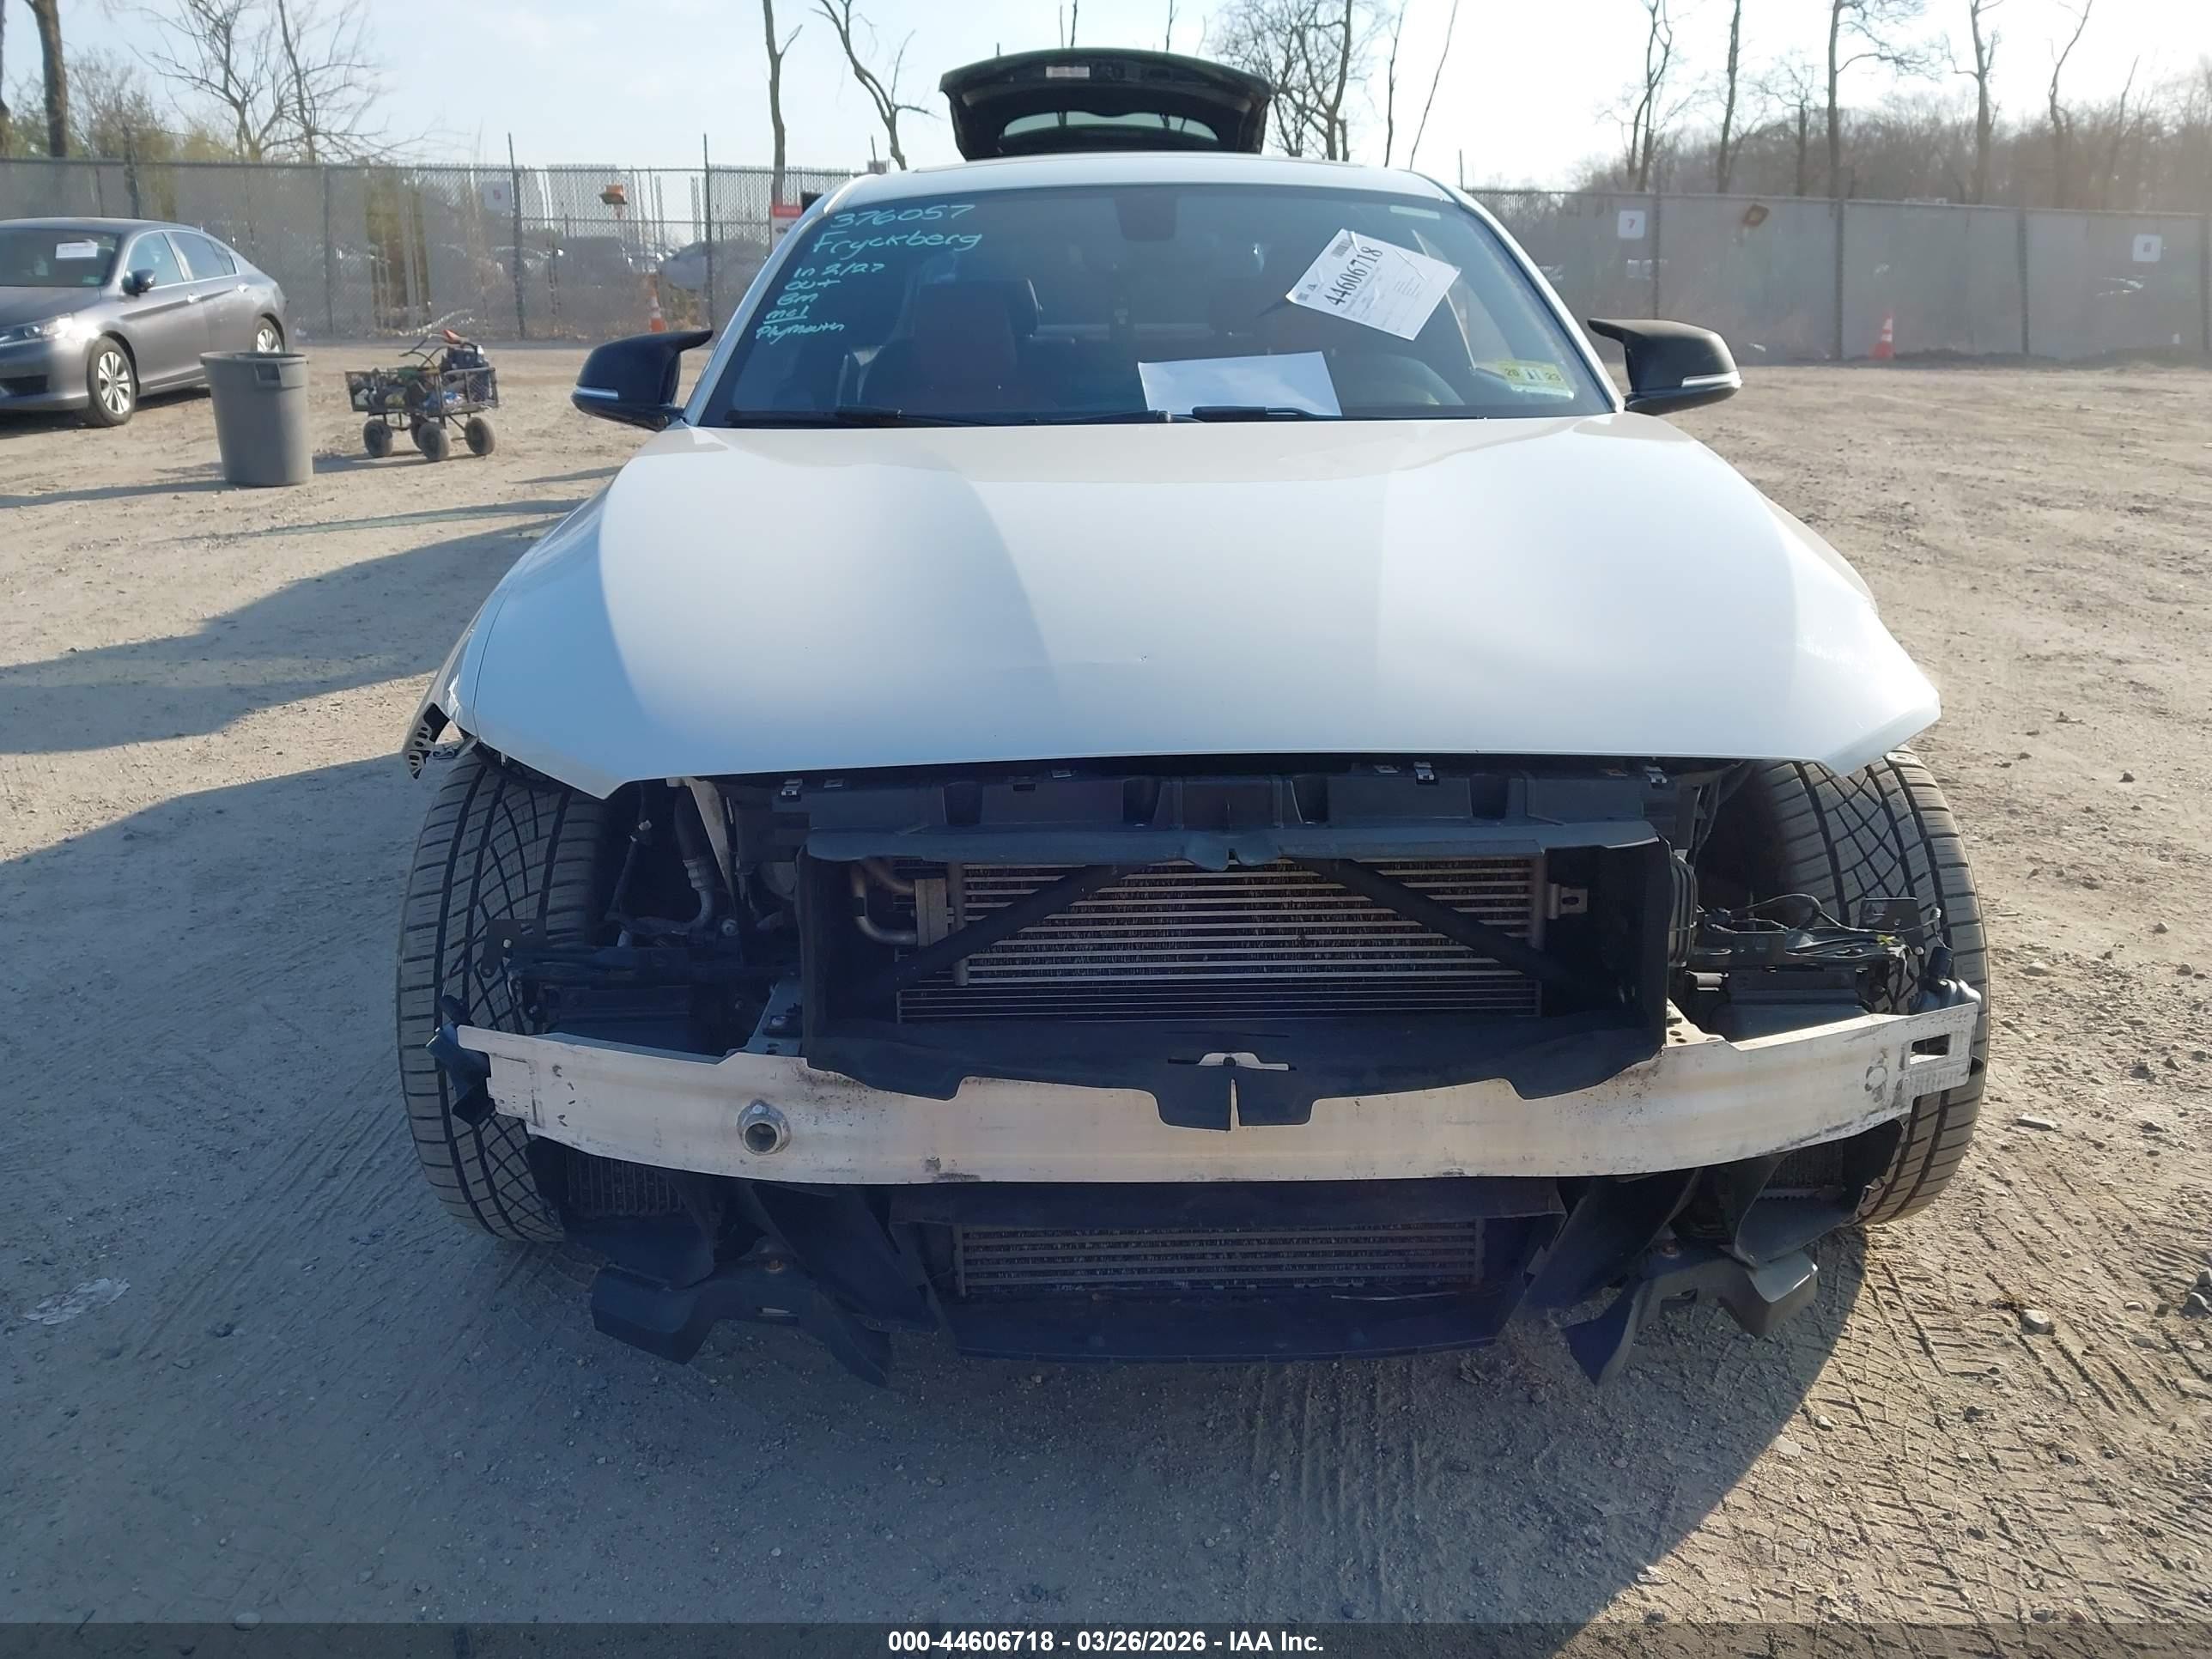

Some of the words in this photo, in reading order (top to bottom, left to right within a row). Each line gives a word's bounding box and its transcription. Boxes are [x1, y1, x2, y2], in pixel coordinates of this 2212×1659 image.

[830, 204, 975, 228] 376057
[813, 229, 983, 261] Fryckberg
[1324, 246, 1383, 307] 44606718
